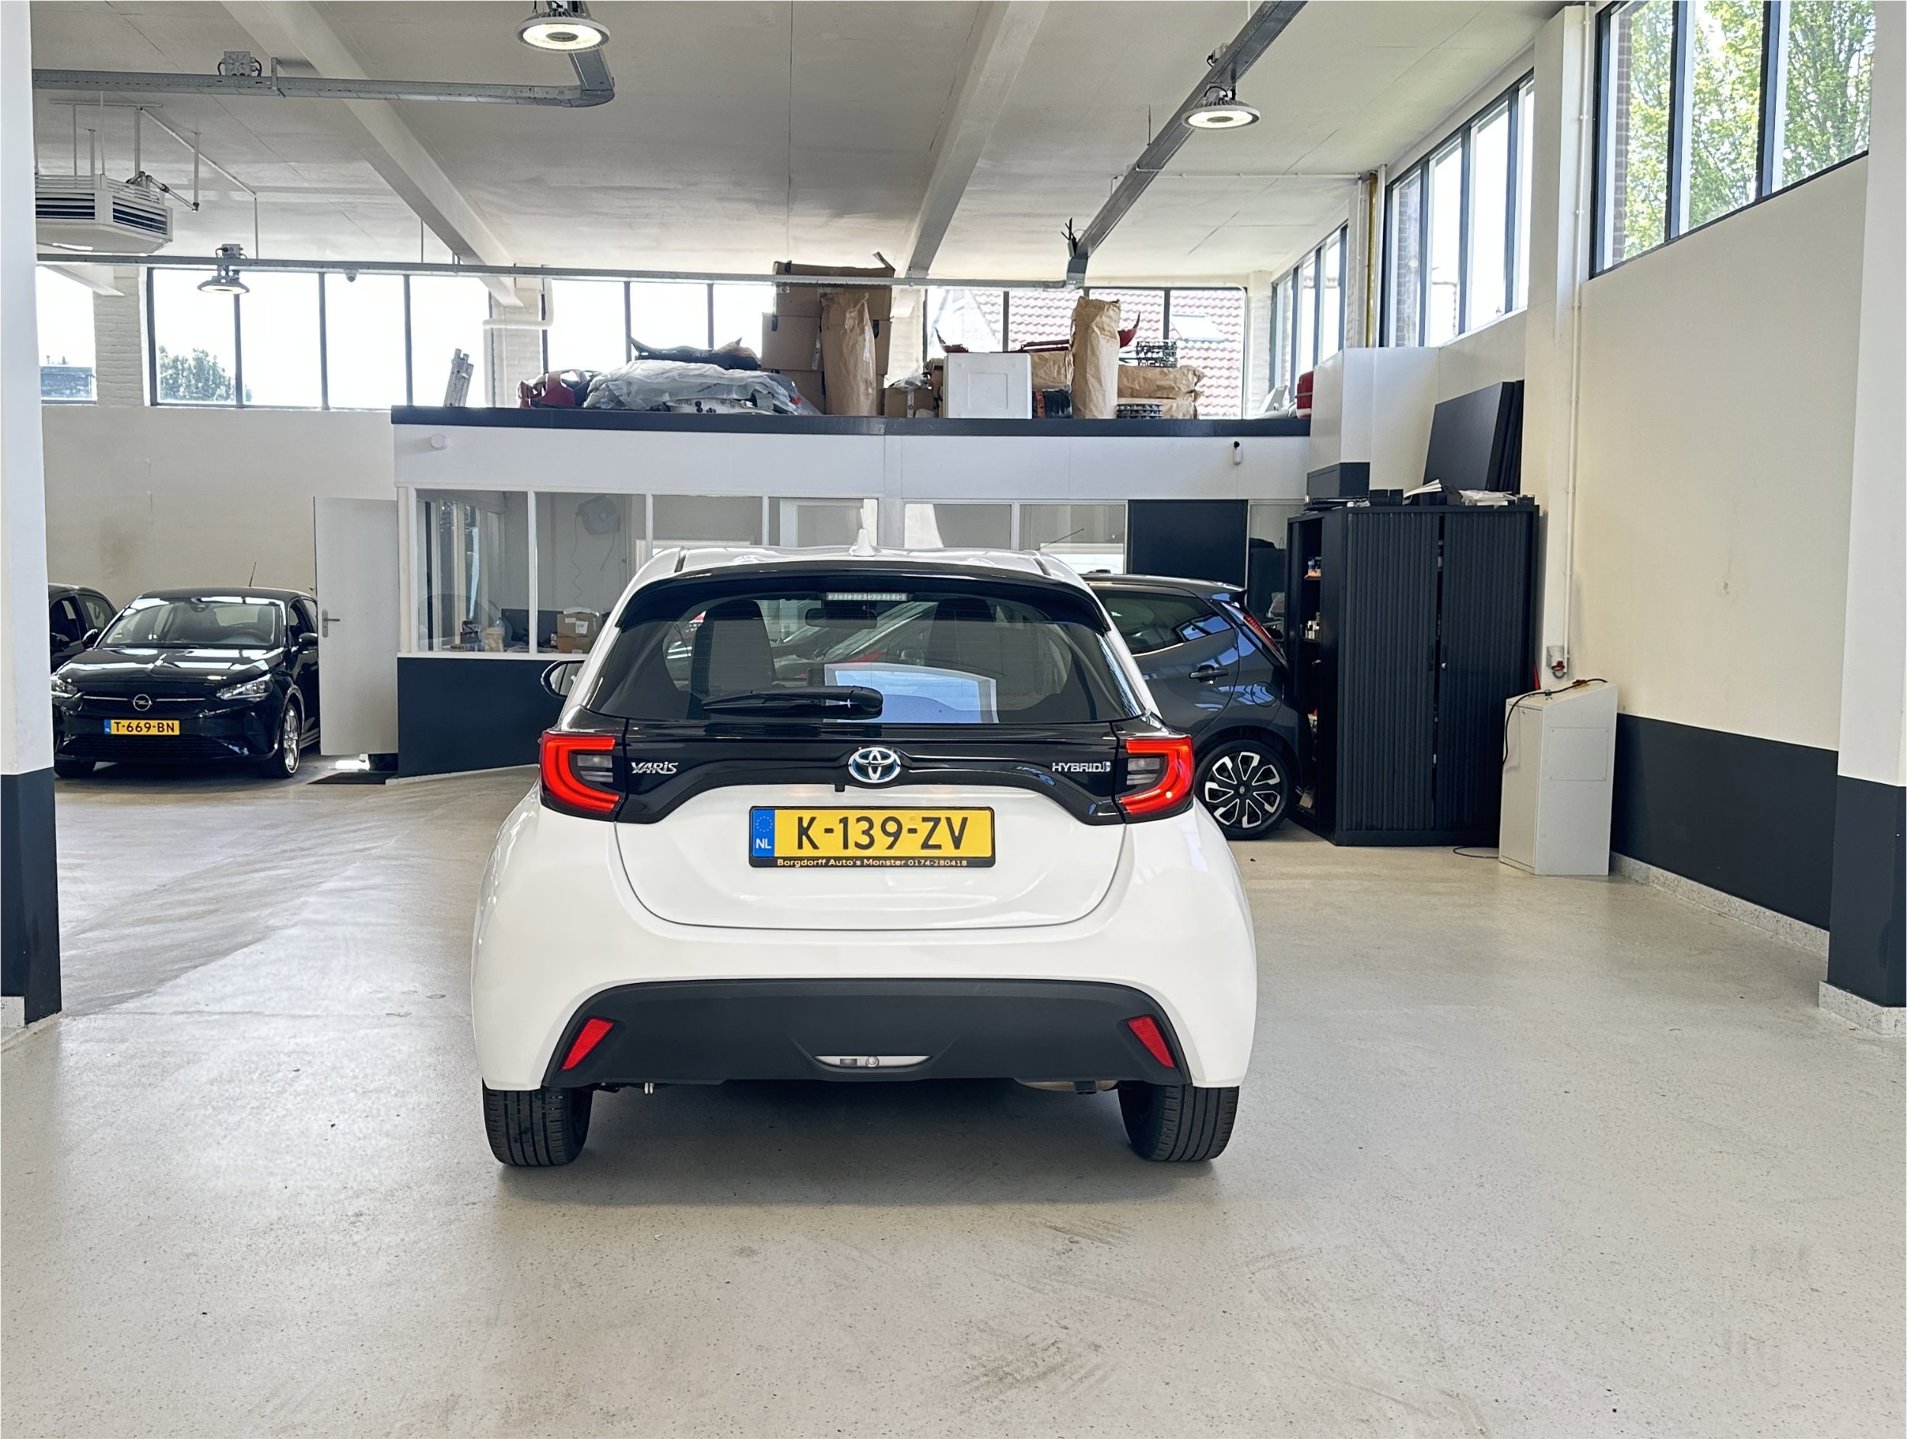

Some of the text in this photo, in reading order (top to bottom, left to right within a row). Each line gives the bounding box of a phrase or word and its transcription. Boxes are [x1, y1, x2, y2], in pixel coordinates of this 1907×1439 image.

[113, 721, 175, 733] T-669-BN
[797, 816, 969, 850] K-139-ZV
[755, 838, 772, 849] NL
[777, 858, 967, 868] Borgdorff Auto's Monster 0174-280418
